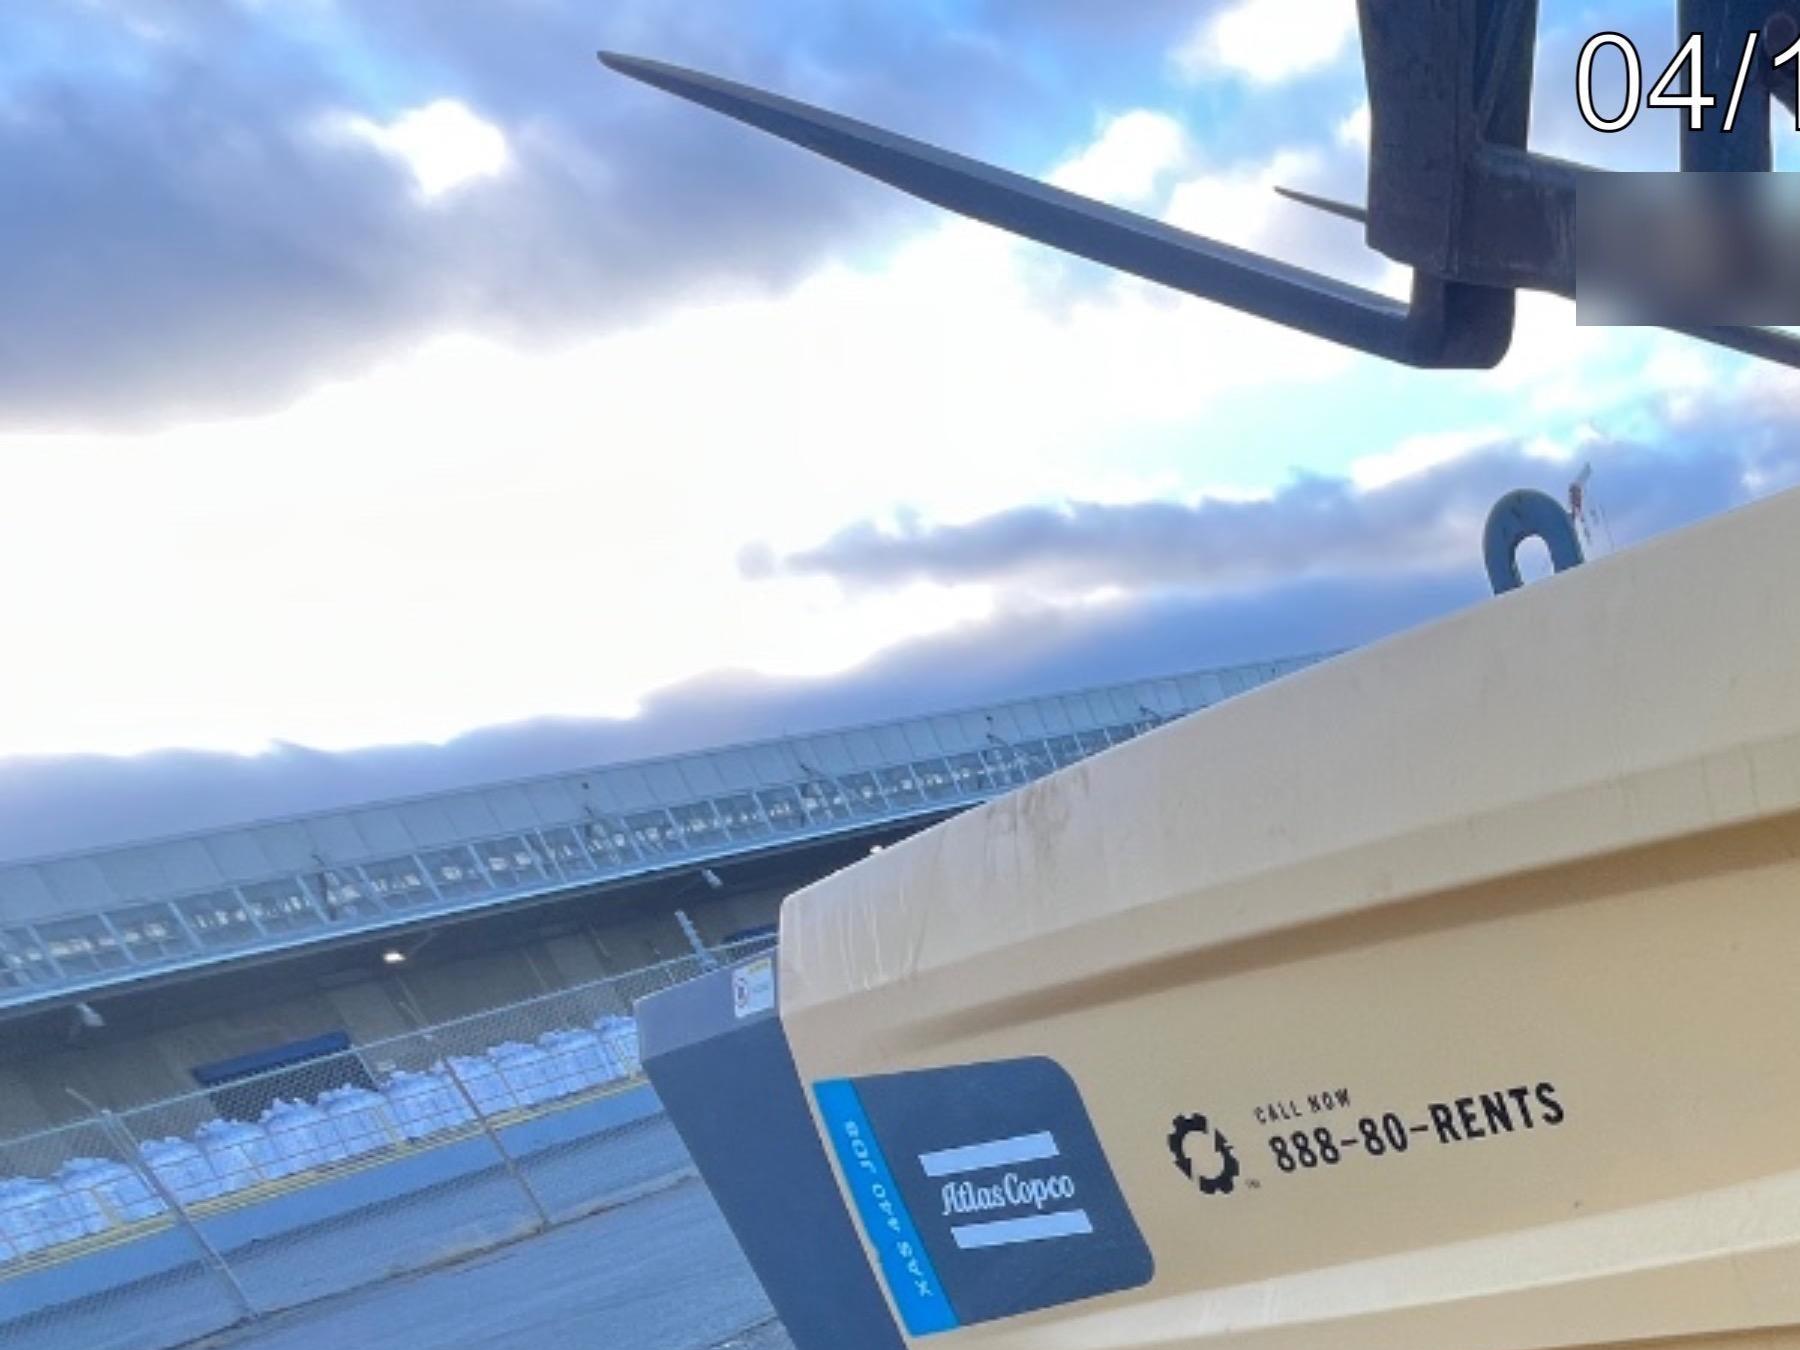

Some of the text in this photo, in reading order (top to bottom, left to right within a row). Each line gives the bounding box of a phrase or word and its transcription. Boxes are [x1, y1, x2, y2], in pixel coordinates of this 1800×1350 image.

[1254, 1088, 1351, 1125] CALL NOW
[1268, 1082, 1565, 1172] 888-80-RENTS
